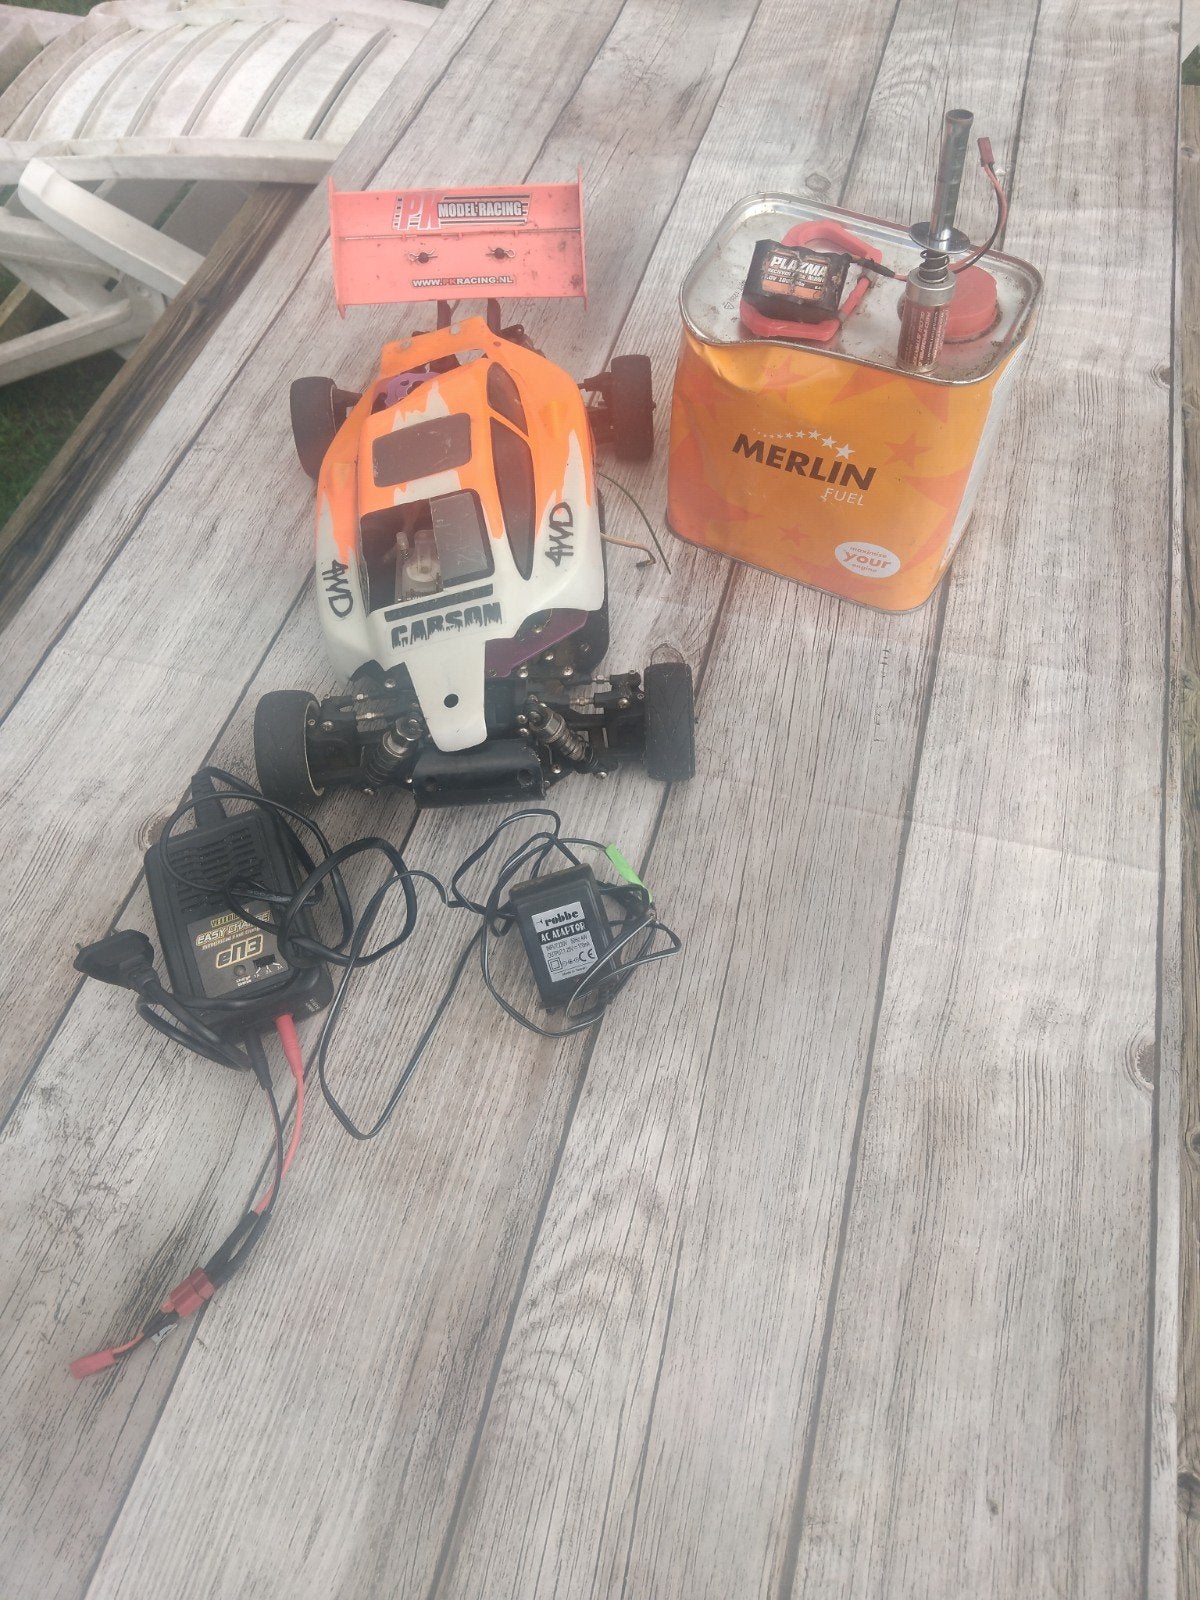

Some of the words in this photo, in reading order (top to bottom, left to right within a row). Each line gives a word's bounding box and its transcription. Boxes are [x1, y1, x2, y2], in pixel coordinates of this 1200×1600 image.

[437, 201, 478, 218] MODEL
[479, 201, 522, 217] RACING
[412, 276, 514, 288] WWW.PKRACING.NL
[732, 433, 877, 491] MERLIN
[824, 487, 864, 506] FUEL
[544, 501, 574, 568] 4WD
[843, 551, 892, 570] your
[321, 559, 354, 618] 4WD
[391, 602, 503, 649] CARSON
[544, 910, 579, 927] robbe
[196, 926, 228, 946] EASY
[541, 932, 551, 942] AC
[552, 921, 586, 939] ADAPTOR
